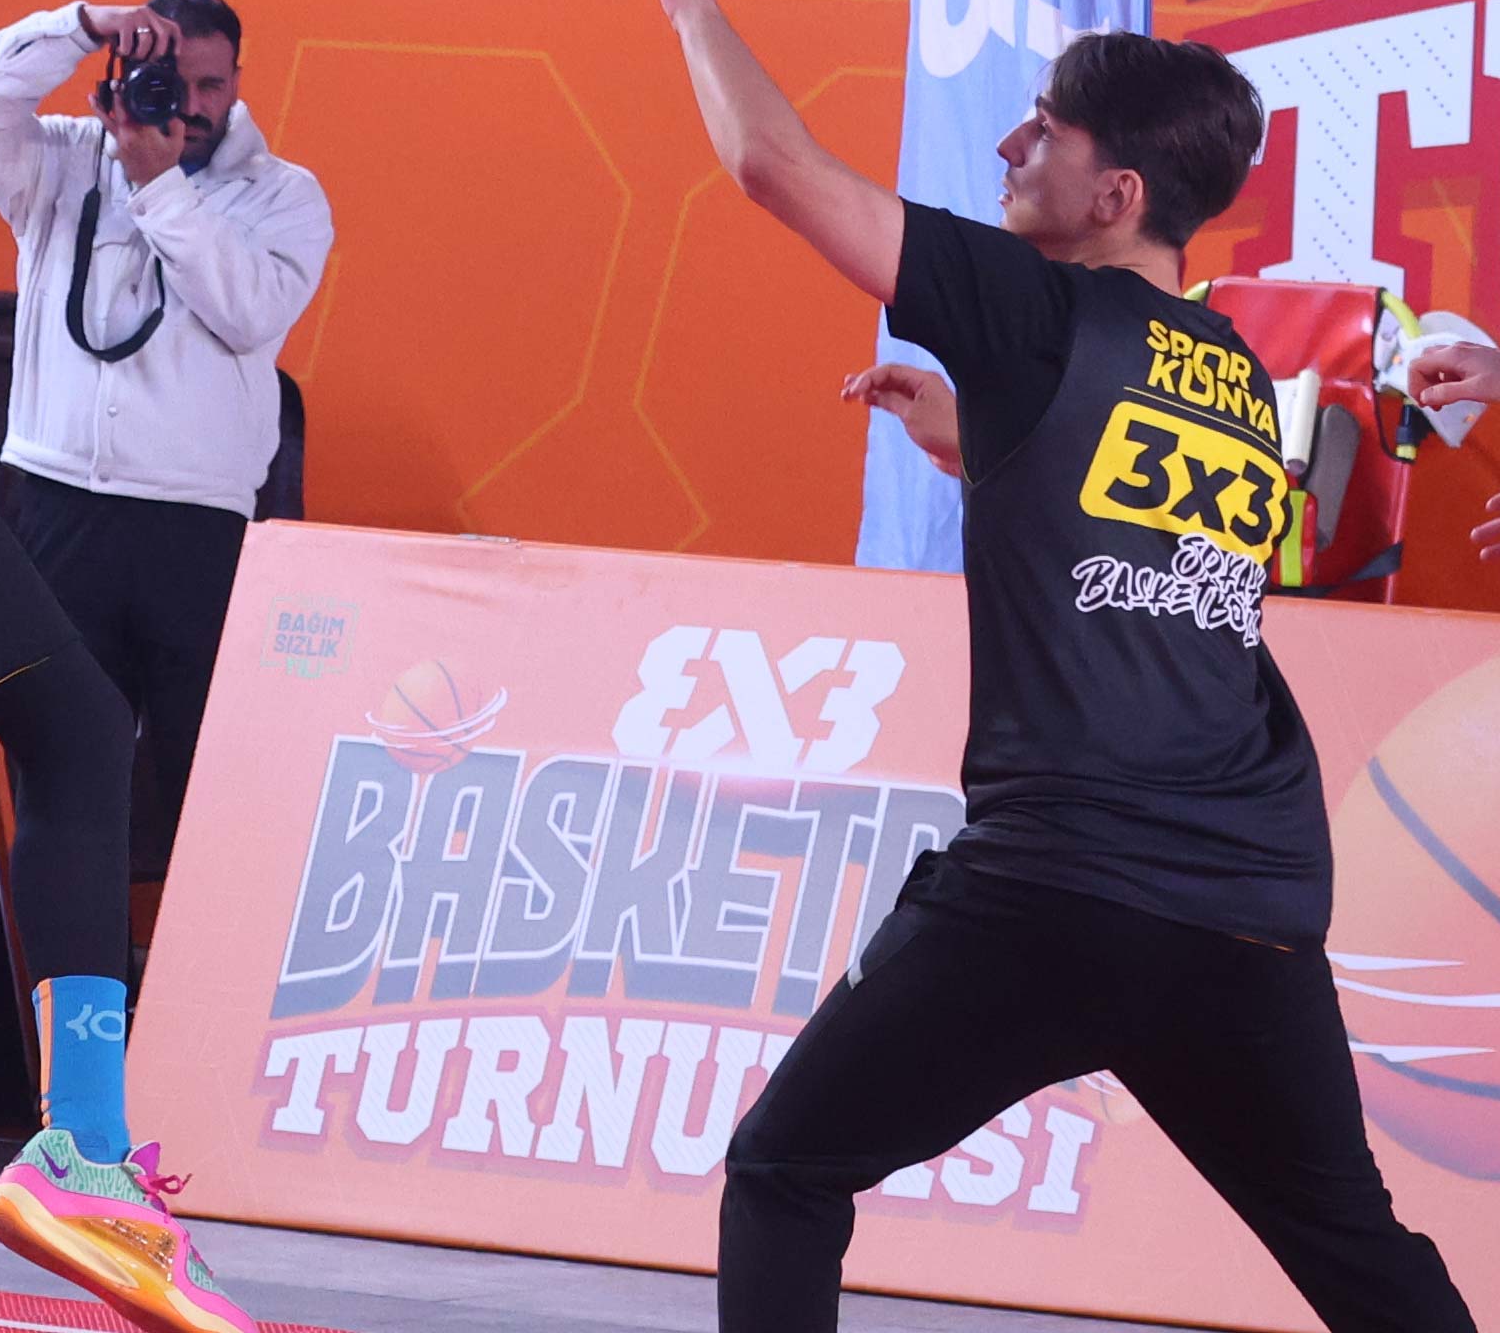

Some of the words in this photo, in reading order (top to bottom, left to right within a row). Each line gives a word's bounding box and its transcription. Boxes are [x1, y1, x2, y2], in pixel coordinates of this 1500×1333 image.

[1146, 319, 1252, 391] SPOR
[1146, 353, 1278, 443] KONYA
[277, 611, 346, 636] BAĞIM
